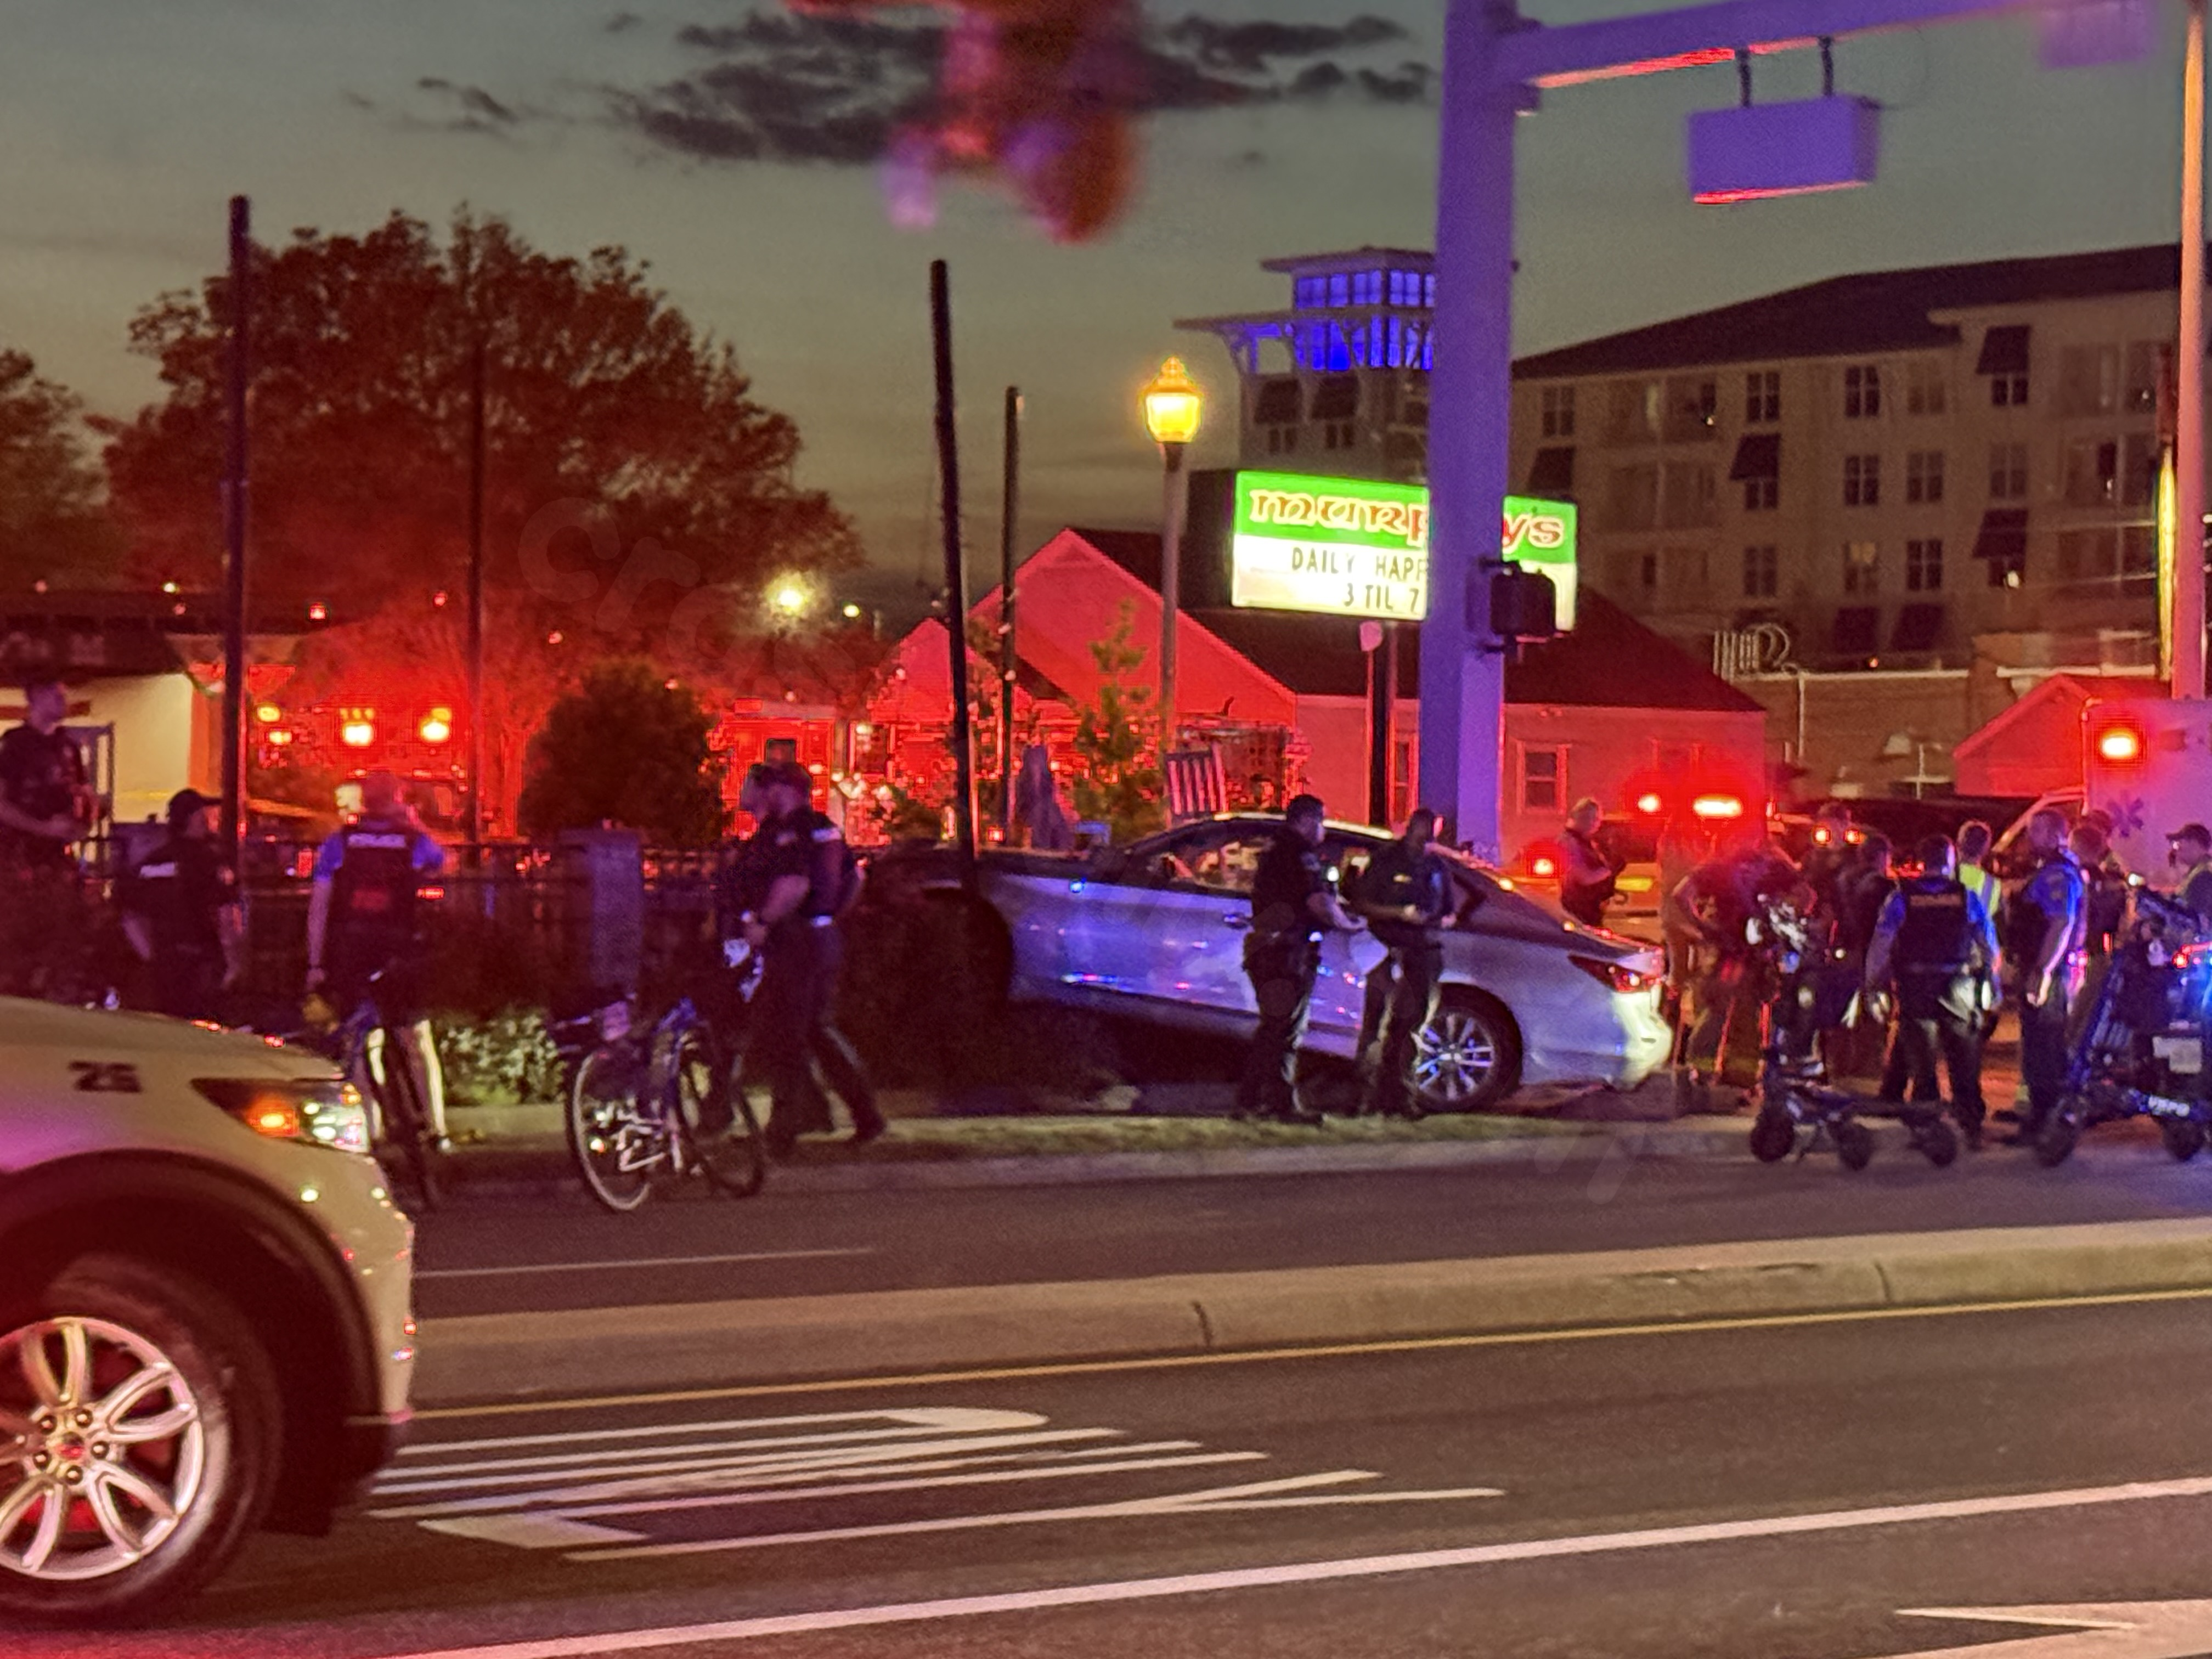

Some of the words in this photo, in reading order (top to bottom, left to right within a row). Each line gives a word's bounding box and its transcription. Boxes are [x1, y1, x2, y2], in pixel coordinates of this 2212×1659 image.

[1291, 547, 1356, 574] DAILY
[1375, 555, 1429, 582] HAPP
[1344, 583, 1355, 607] 3
[1365, 584, 1393, 611] TIL
[1409, 587, 1420, 613] 7
